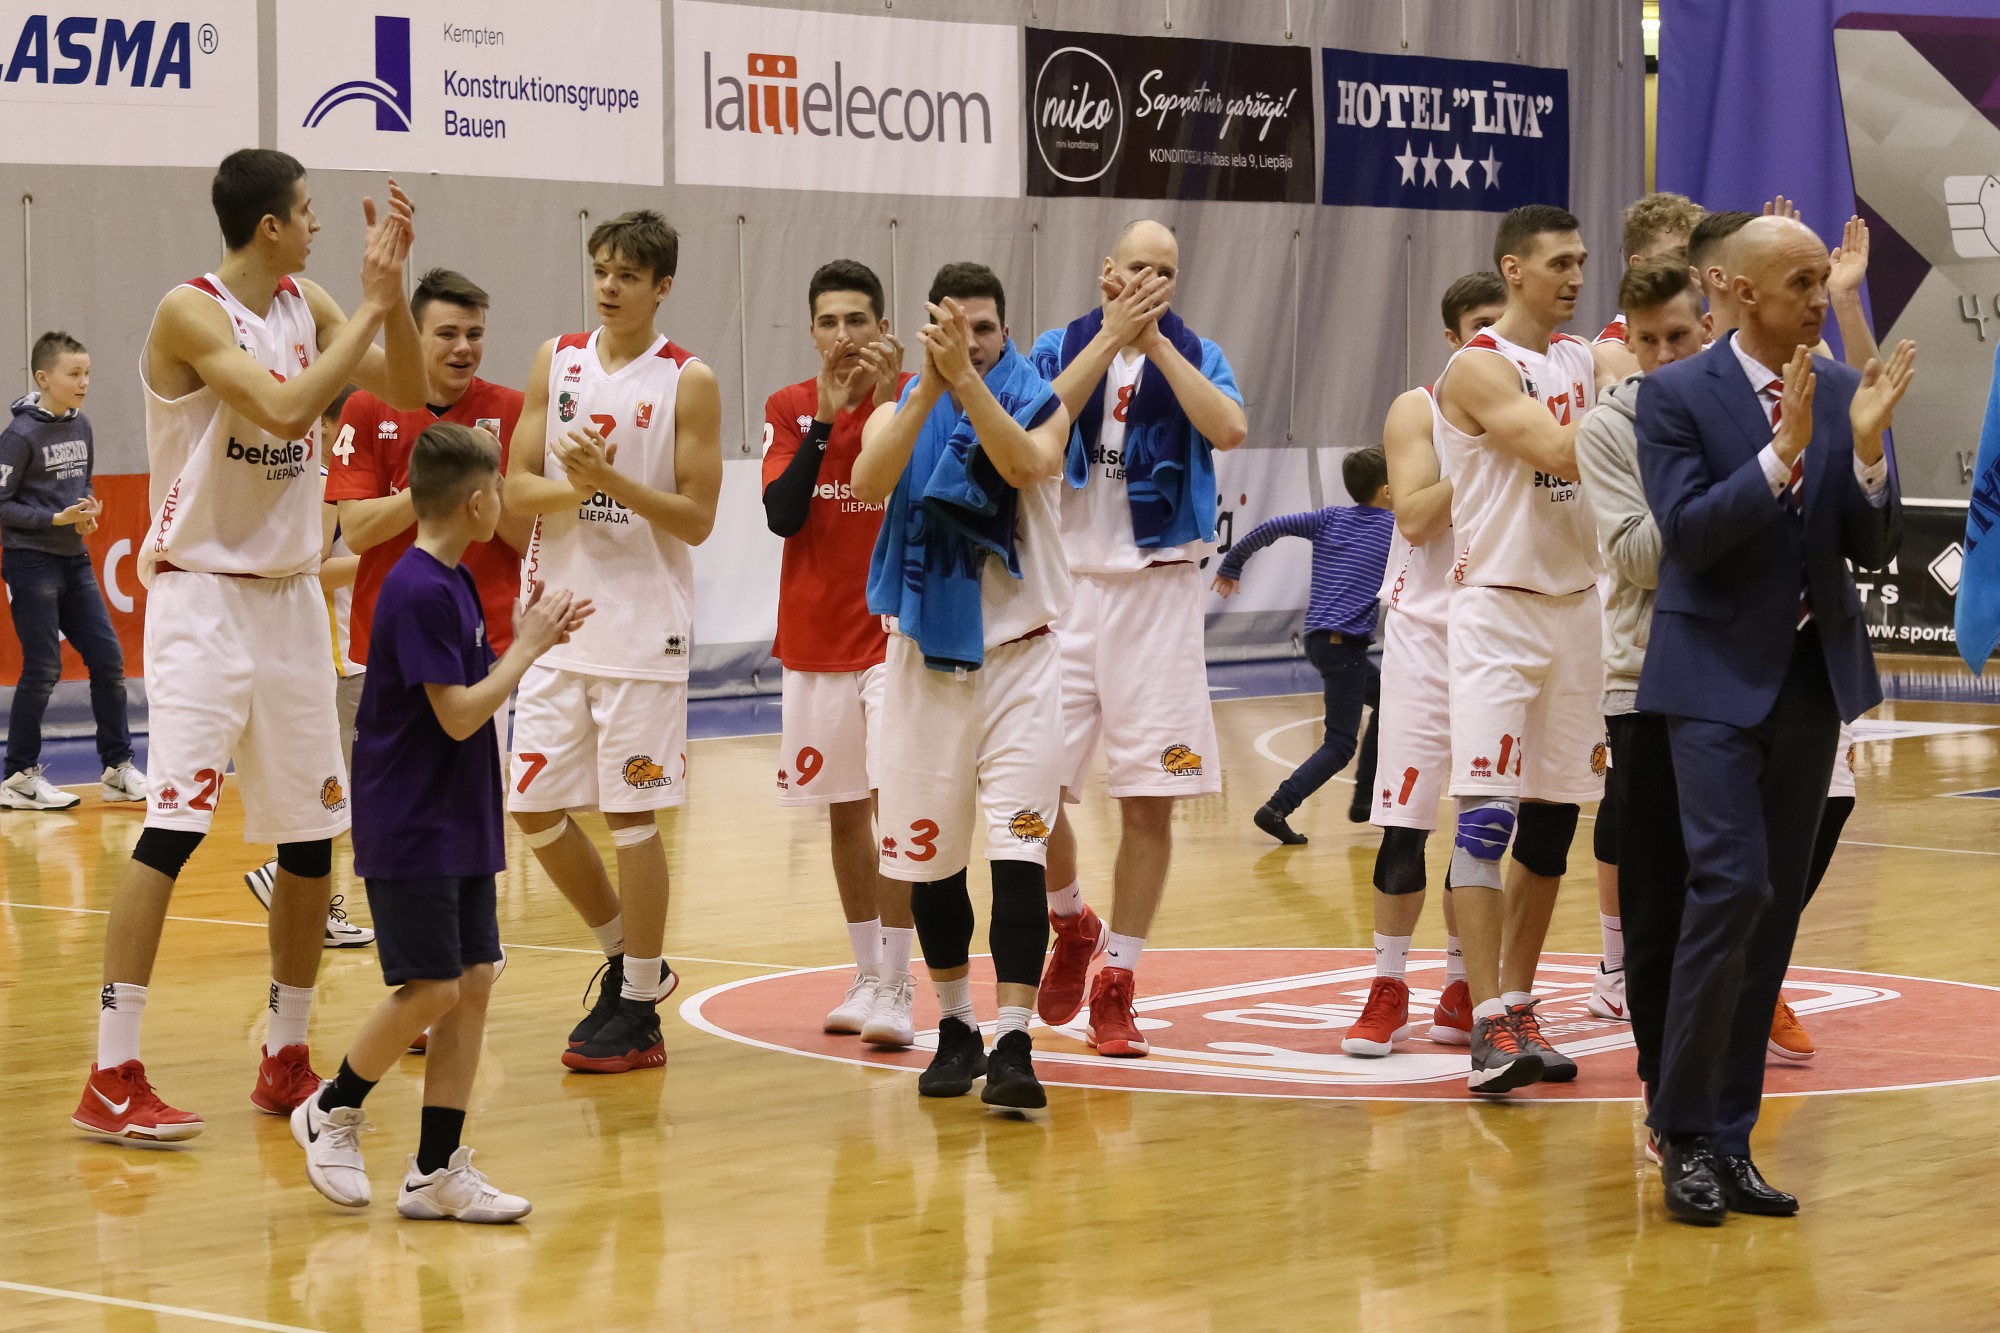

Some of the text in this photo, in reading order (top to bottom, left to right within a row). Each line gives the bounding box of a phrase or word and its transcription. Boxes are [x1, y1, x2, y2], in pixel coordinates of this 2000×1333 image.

[443, 22, 505, 49] Kempten
[443, 69, 640, 114] Konstruktionsgruppe
[1336, 79, 1451, 132] HOTEL
[1042, 81, 1115, 135] miko
[444, 109, 507, 140] Bauen
[1231, 152, 1248, 168] iela
[1259, 153, 1294, 172] Liepāja
[41, 439, 88, 467] LEGEND
[226, 436, 304, 466] betsafe
[67, 467, 84, 479] YORK
[578, 508, 630, 525] LIEPĀJA
[516, 752, 548, 794] 7
[795, 746, 824, 787] 9
[1470, 768, 1492, 778] errea
[1397, 766, 1420, 806] 1
[157, 801, 179, 810] errea
[904, 818, 940, 862] 3
